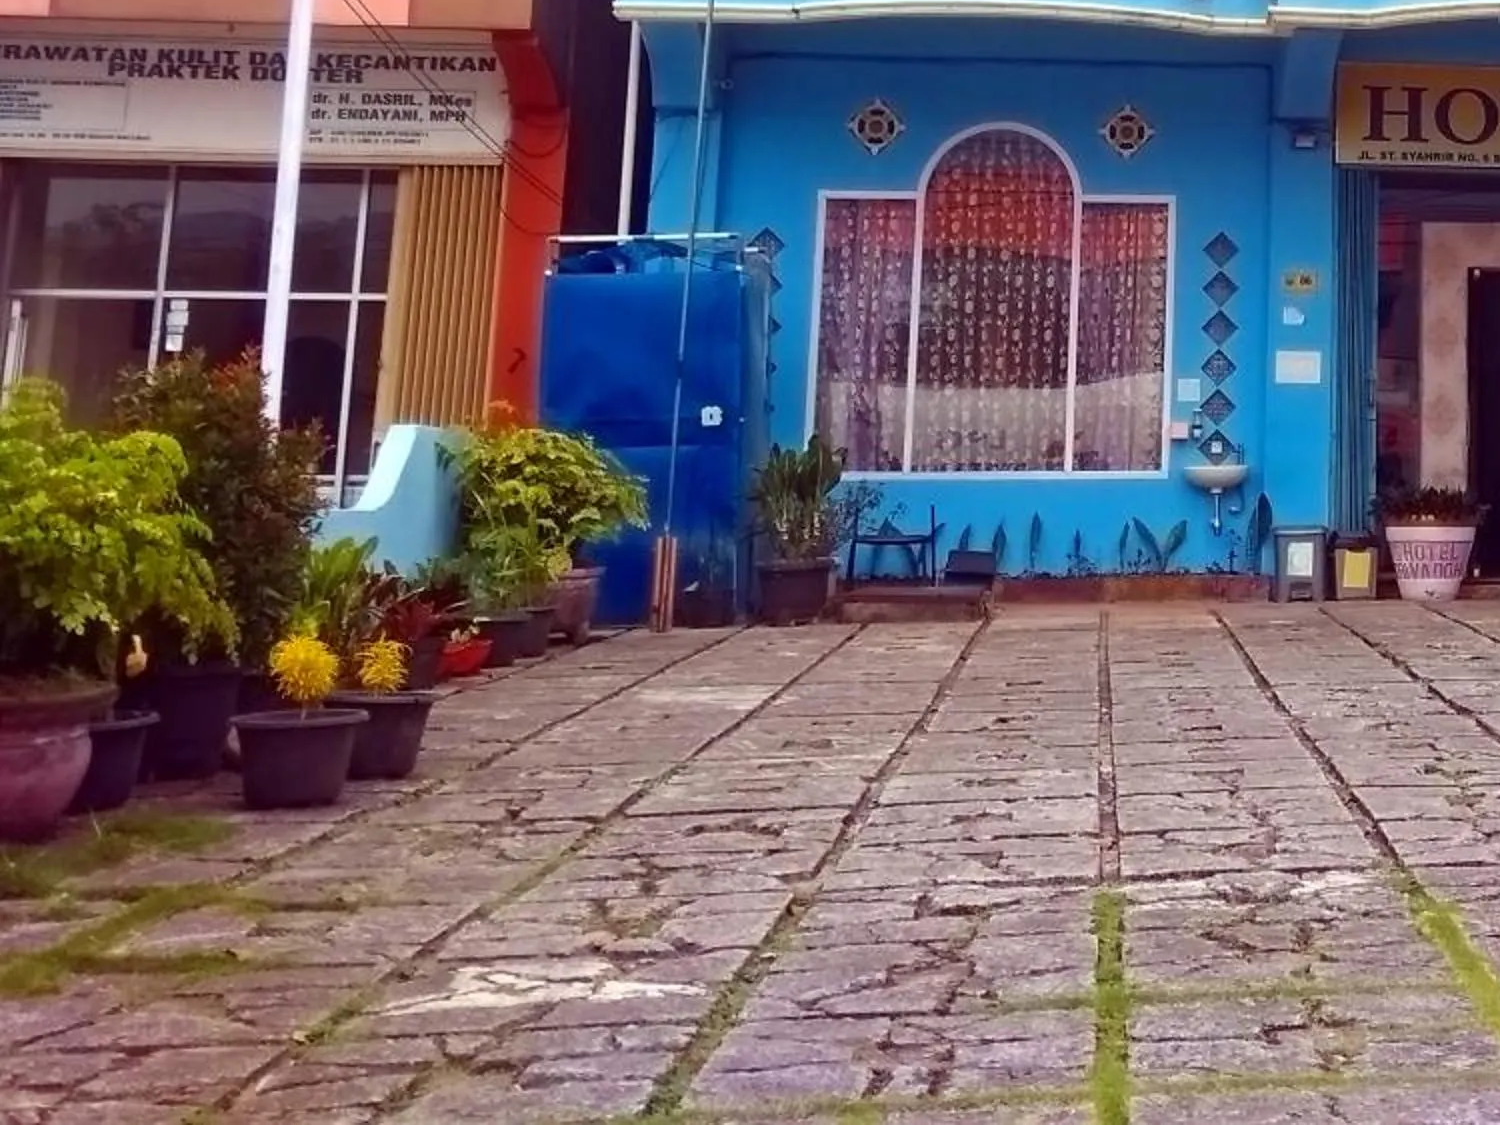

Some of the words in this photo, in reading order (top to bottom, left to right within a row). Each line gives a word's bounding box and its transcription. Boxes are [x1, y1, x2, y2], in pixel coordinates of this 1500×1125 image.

[0, 44, 147, 63] RAWATAN
[157, 48, 240, 66] KULIT
[316, 53, 498, 73] KECANTIKAN
[107, 61, 241, 81] PRAKTEK
[250, 65, 364, 84] DOTER
